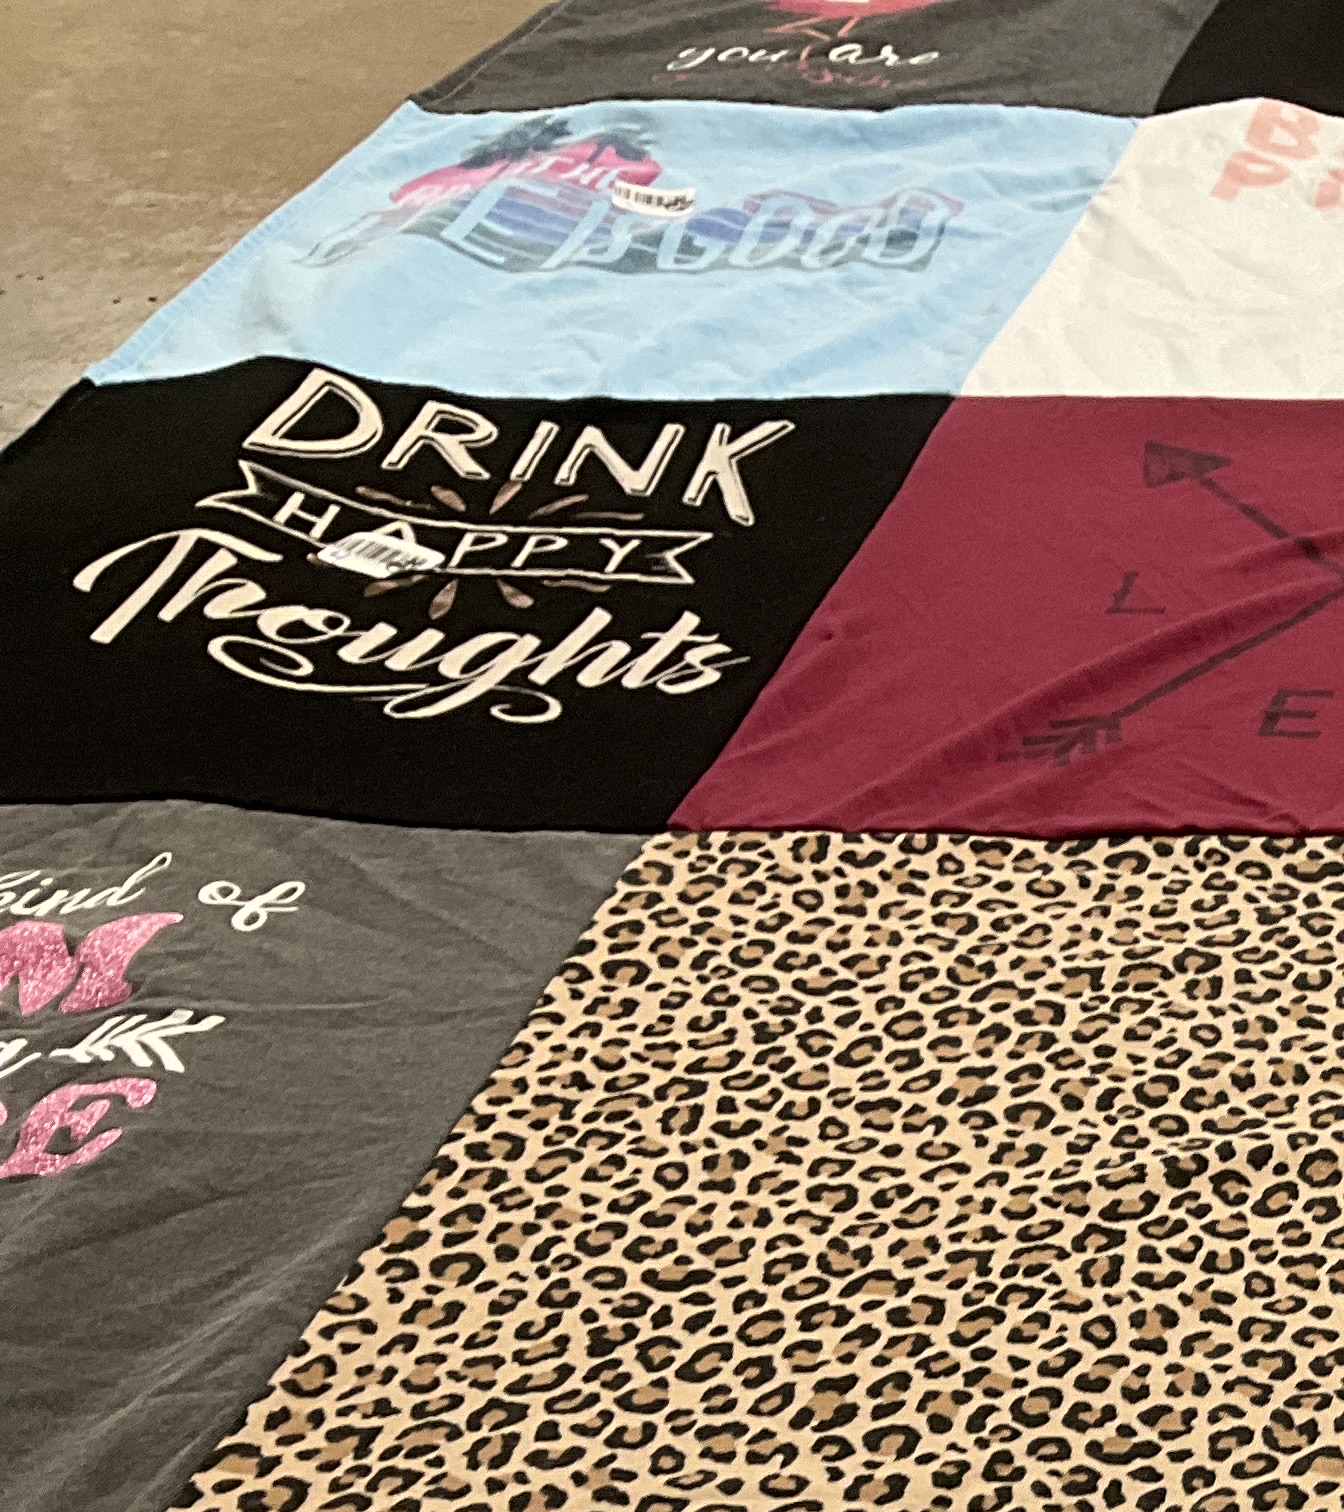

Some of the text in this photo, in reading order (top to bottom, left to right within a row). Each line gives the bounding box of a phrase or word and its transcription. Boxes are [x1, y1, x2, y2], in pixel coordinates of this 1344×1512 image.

[666, 42, 940, 71] you are
[242, 368, 796, 526] DRINK
[73, 528, 751, 723] Thoughts
[197, 879, 307, 933] of
